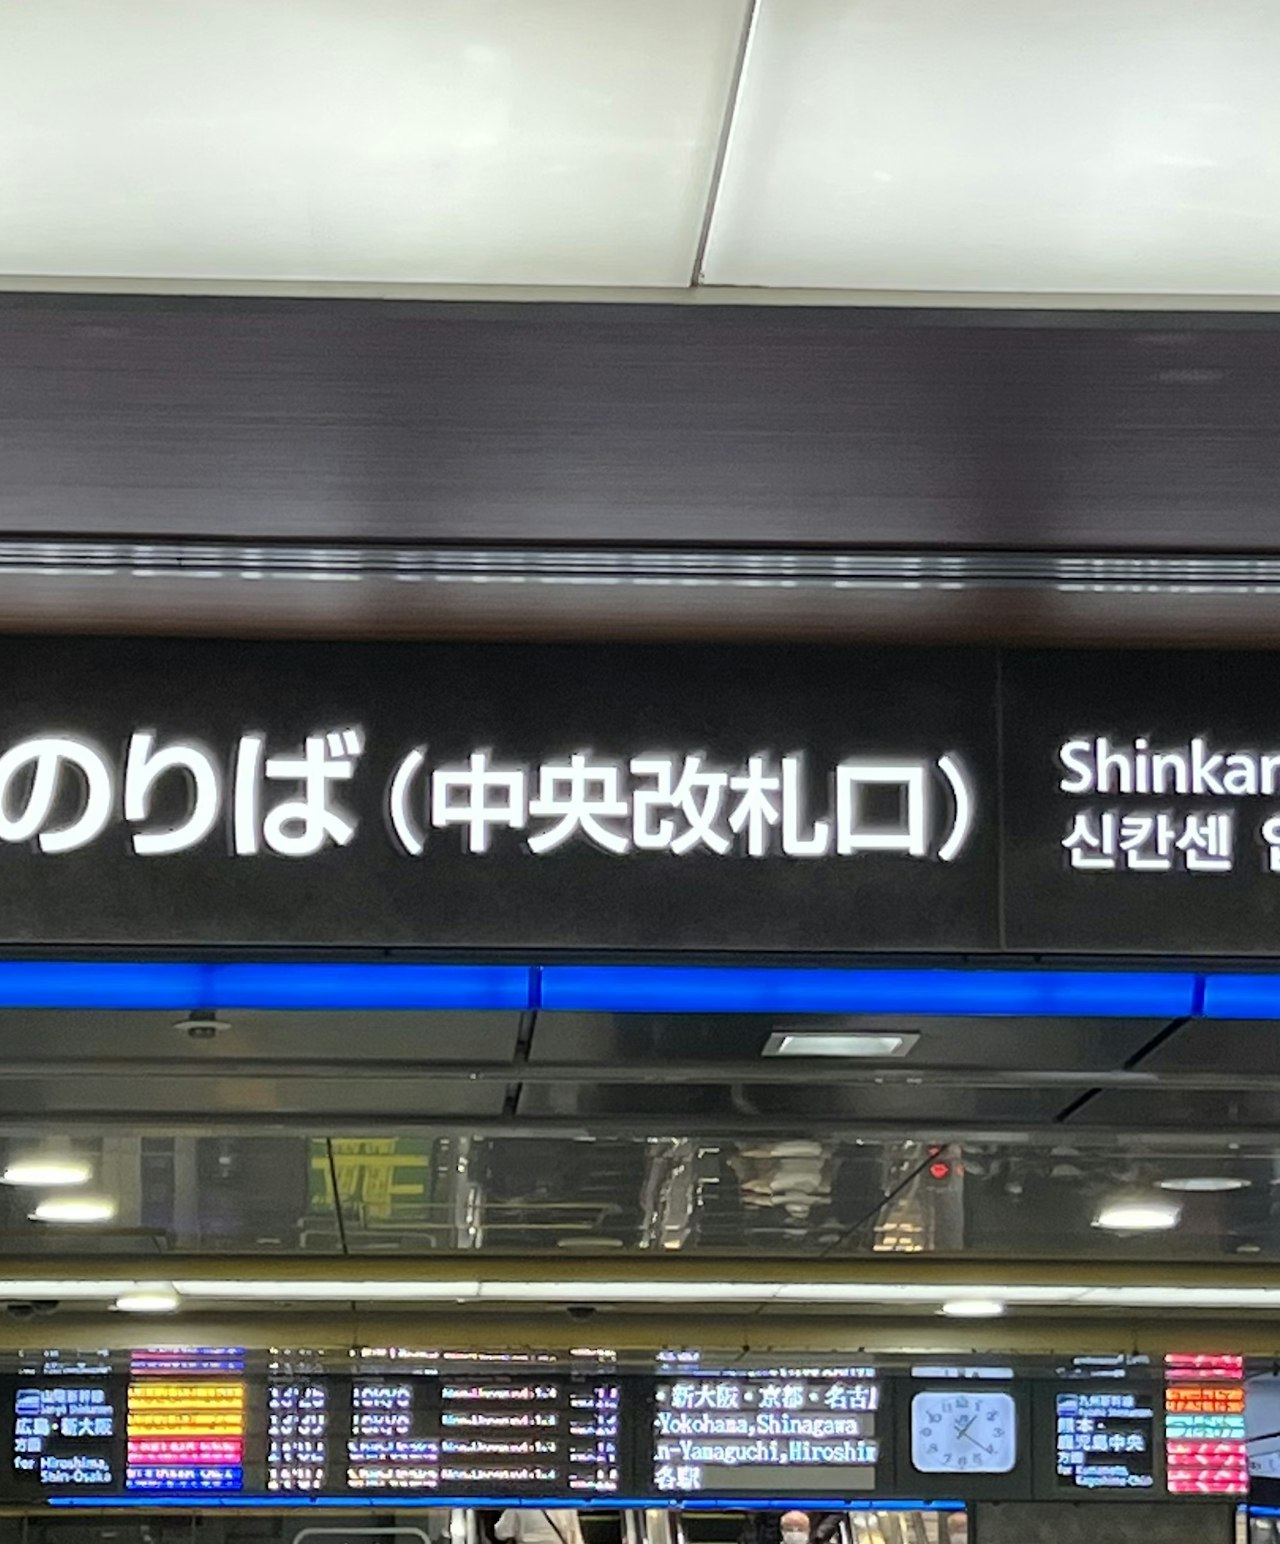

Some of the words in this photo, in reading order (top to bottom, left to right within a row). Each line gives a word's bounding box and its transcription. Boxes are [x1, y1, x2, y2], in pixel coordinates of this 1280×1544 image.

[391, 751, 970, 860] (中央改札口)
[1062, 813, 1232, 872] 신칸센
[654, 1465, 703, 1491] 各駅
